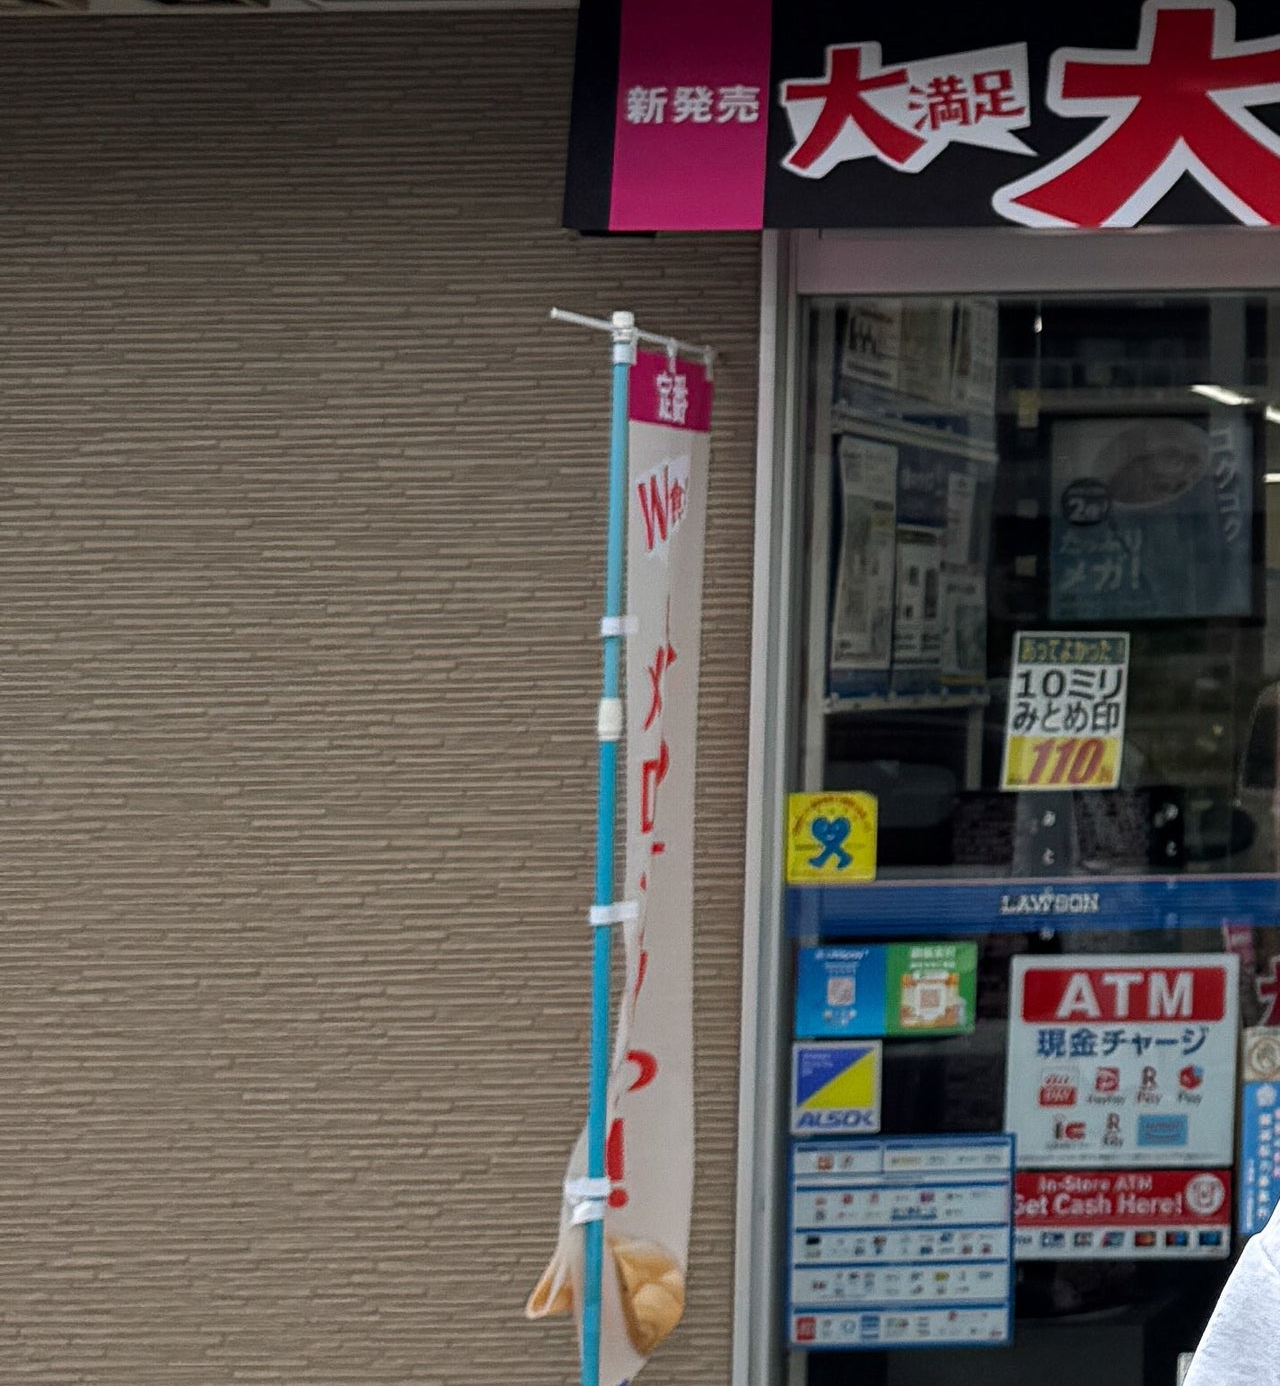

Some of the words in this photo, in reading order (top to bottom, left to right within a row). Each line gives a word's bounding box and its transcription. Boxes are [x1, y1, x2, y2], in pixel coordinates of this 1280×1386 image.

[626, 85, 760, 124] 新発売
[786, 46, 1027, 171] 大満足
[1016, 668, 1123, 700] 10ミリ
[1012, 700, 1120, 733] みとめ印
[1027, 737, 1105, 785] 110
[1000, 893, 1099, 914] LAWSON
[1056, 972, 1194, 1018] ATM
[1037, 1026, 1209, 1057] 現金チャージ
[797, 1110, 874, 1128] ALSOK
[1039, 1176, 1110, 1192] In-Store
[1113, 1175, 1153, 1191] ATM
[1053, 1193, 1112, 1215] Cash
[1117, 1192, 1183, 1215] Here!
